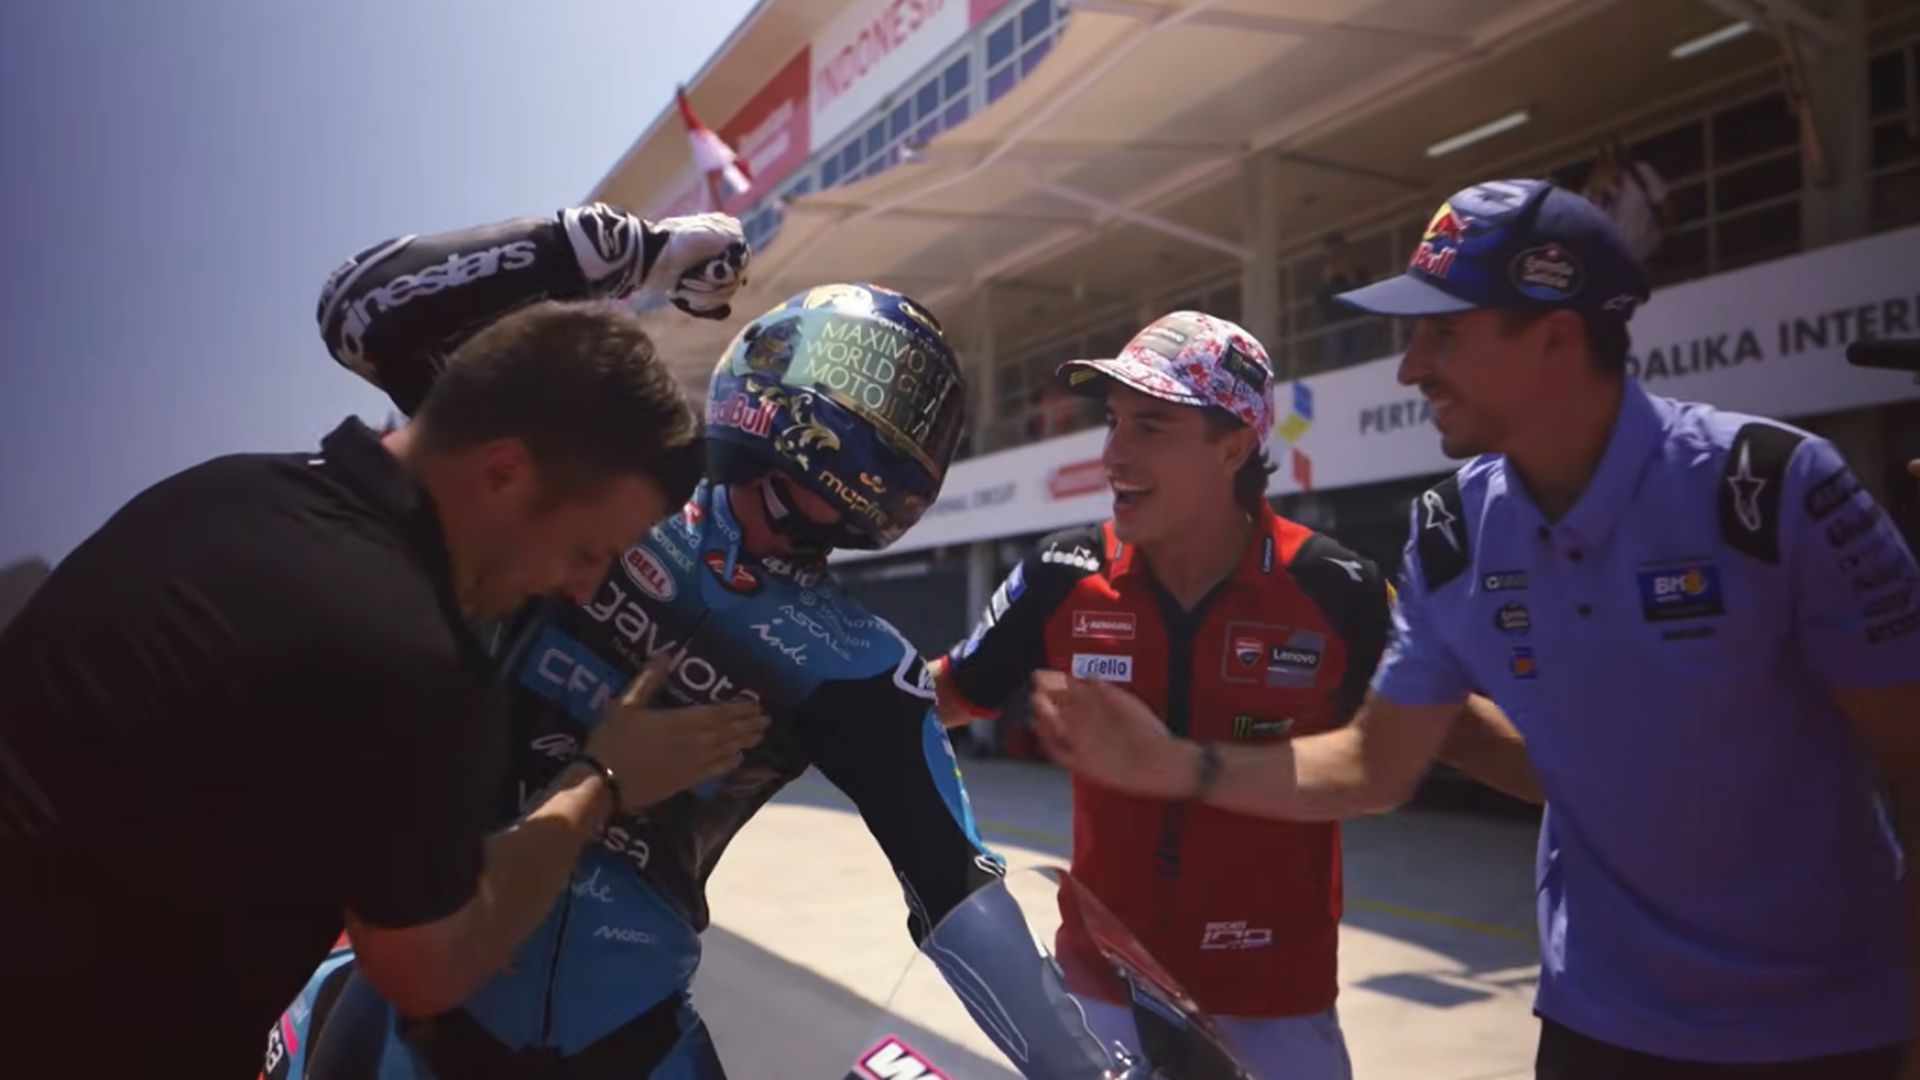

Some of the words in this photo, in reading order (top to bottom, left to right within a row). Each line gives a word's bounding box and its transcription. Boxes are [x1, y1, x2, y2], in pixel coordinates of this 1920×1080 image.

[822, 322, 926, 373] MAXIMO
[1778, 294, 1920, 357] INTER
[807, 340, 895, 384] WORLD
[617, 549, 668, 595] BELL
[1273, 648, 1317, 665] Lenovo
